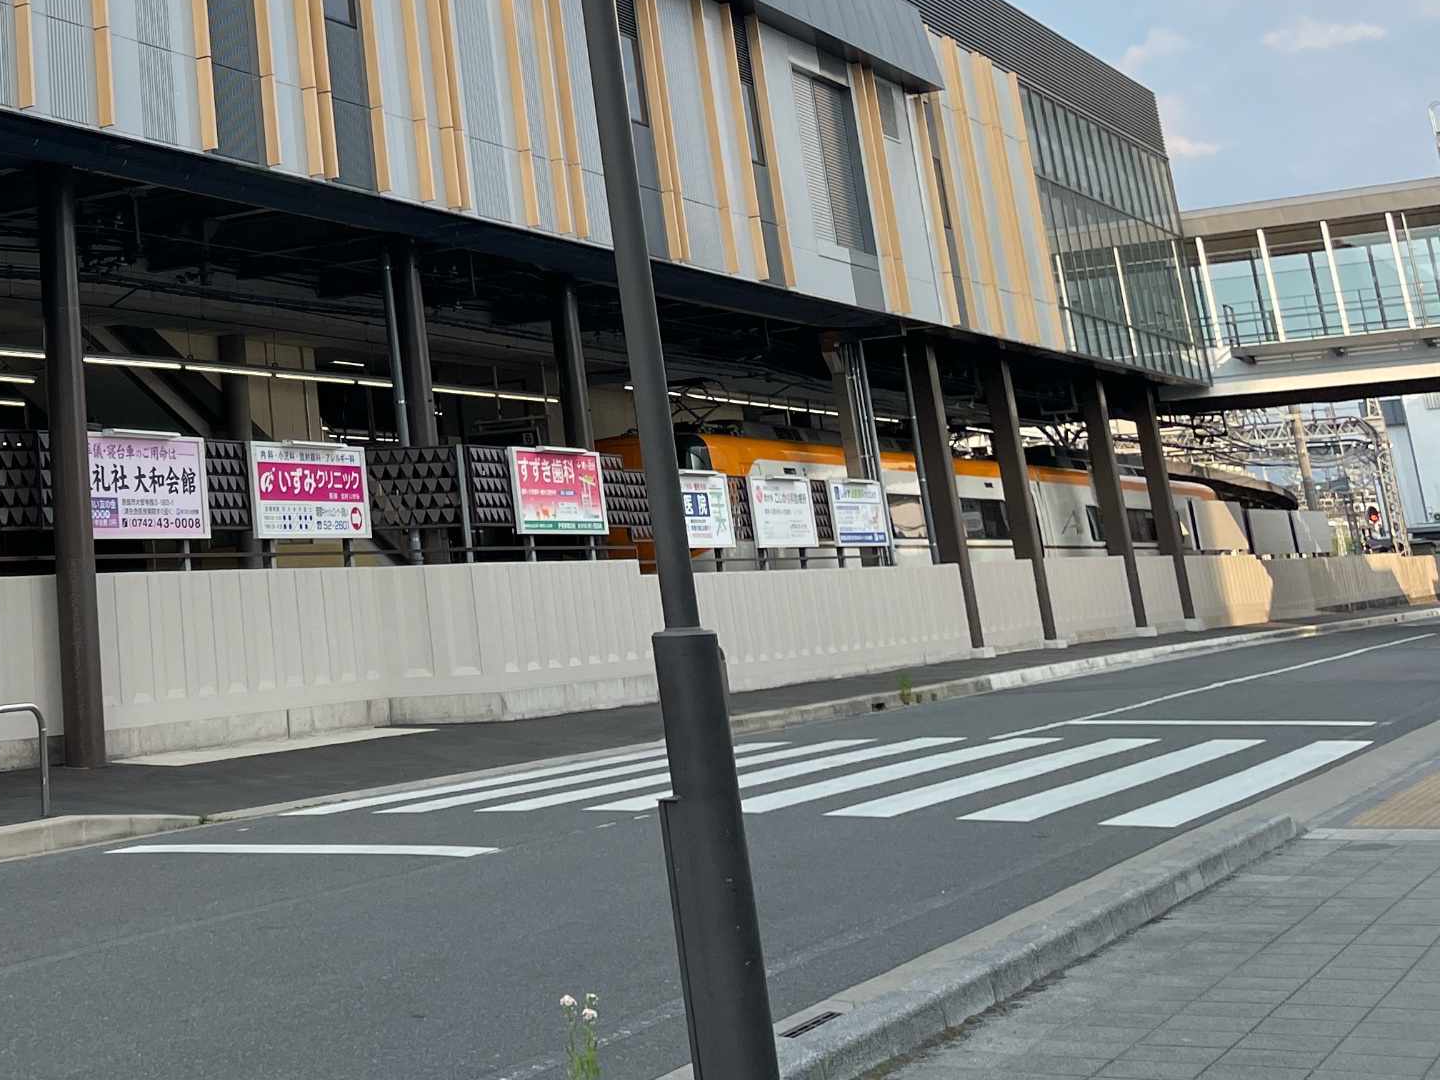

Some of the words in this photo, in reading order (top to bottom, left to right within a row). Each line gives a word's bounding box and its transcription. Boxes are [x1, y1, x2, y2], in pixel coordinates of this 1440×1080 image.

[90, 463, 130, 494] 礼社
[133, 465, 196, 495] 大和会館
[278, 467, 360, 495] いずみクリニック
[517, 456, 575, 484] すずき歯科
